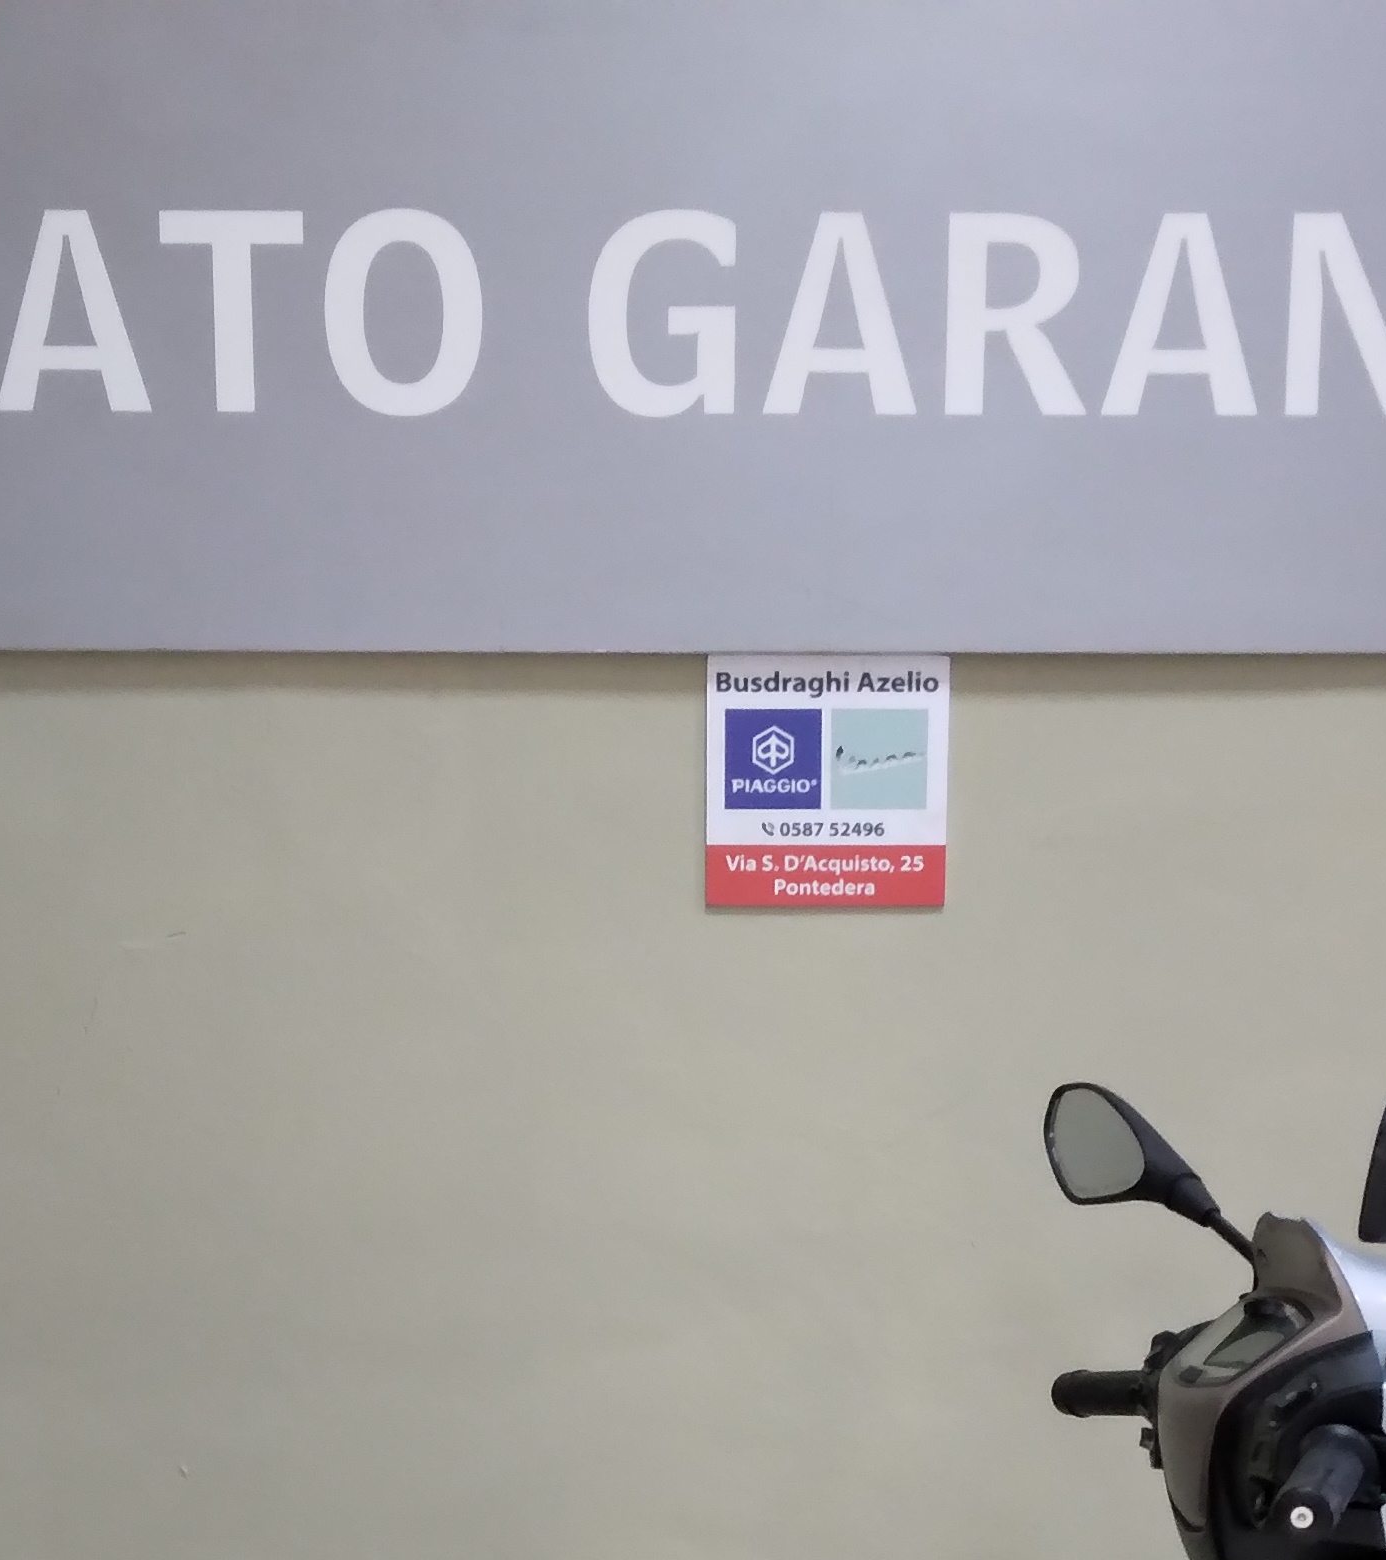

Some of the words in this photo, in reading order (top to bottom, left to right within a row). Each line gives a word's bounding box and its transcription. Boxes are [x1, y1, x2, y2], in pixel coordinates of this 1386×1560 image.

[715, 671, 850, 698] Busdraghi
[857, 671, 940, 693] Azelio
[731, 778, 810, 794] PIAGGIO
[779, 822, 824, 837] 0587
[829, 822, 885, 837] 52496
[726, 855, 756, 872] Via
[762, 855, 780, 872] S.
[784, 855, 895, 875] D'Acquisto,
[900, 855, 924, 872] 25
[774, 879, 875, 896] Pontedera
